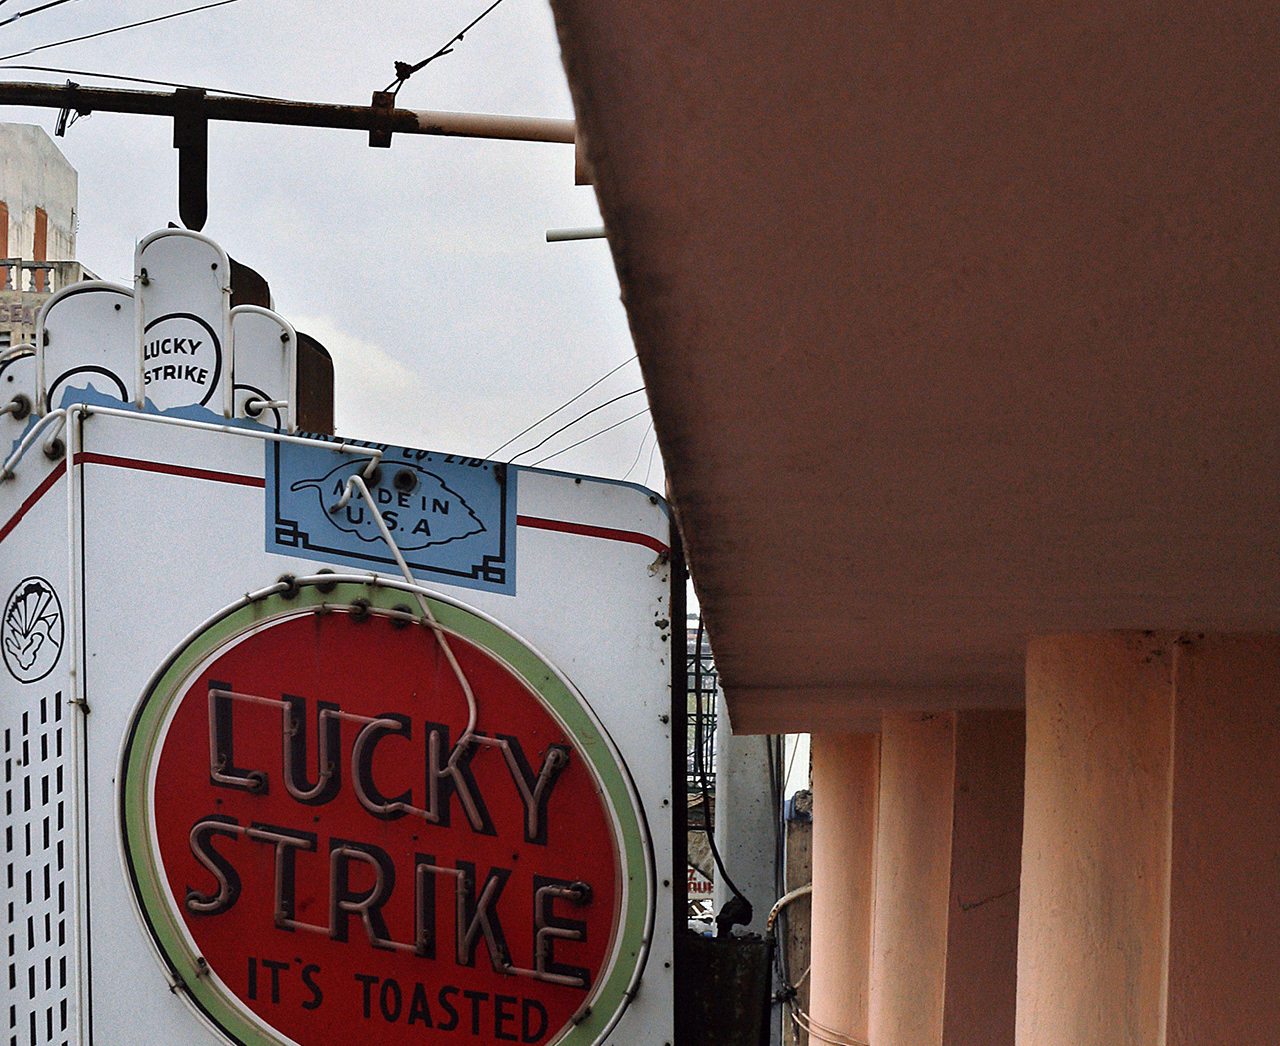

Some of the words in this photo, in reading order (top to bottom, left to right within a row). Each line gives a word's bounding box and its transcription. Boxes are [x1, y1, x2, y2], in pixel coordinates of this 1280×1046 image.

[143, 337, 203, 361] LUCKY
[143, 364, 209, 385] STRIKE
[420, 495, 449, 515] IN
[208, 679, 572, 848] LUCKY
[185, 815, 592, 988] STRIKE
[247, 956, 324, 1011] IT'S
[363, 973, 549, 1045] TOASTED
